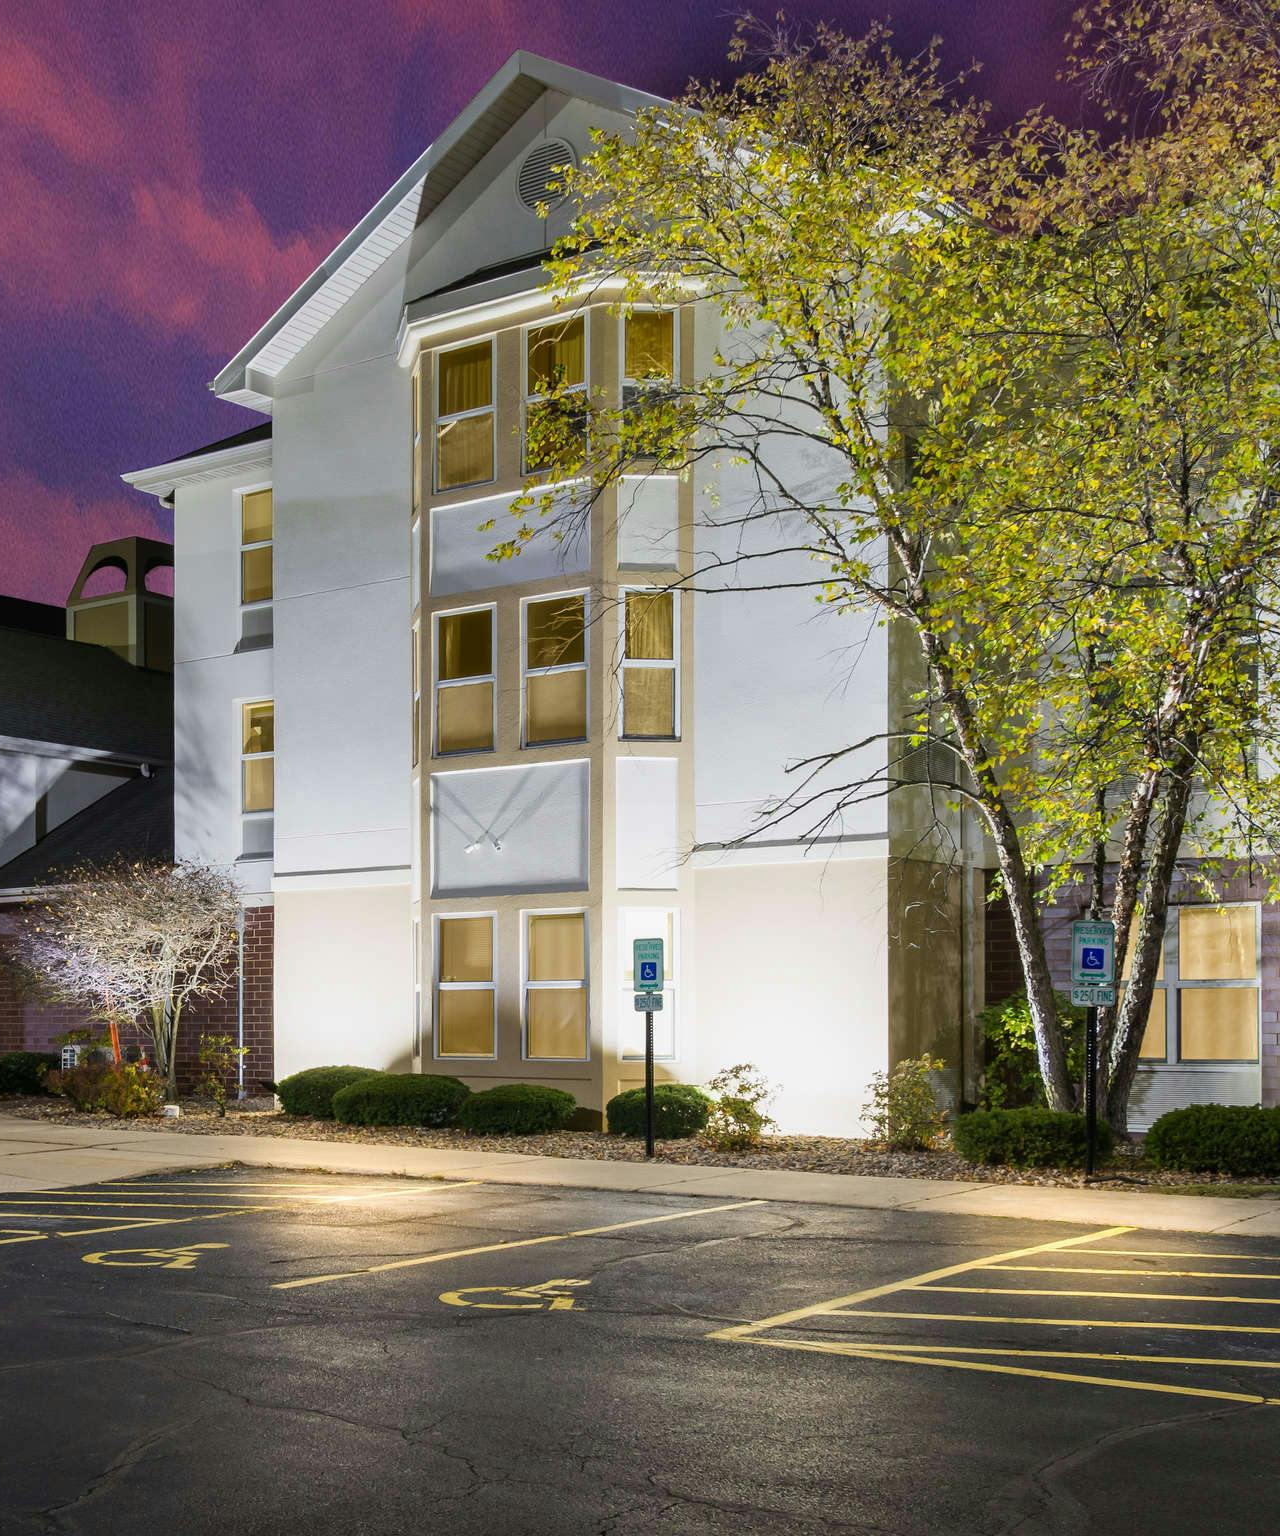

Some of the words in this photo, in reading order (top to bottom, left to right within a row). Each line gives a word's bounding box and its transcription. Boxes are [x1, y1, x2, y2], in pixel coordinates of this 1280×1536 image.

[1075, 927, 1114, 935] RESERVED
[1080, 937, 1109, 945] PARKING
[1097, 990, 1113, 1002] FINE
